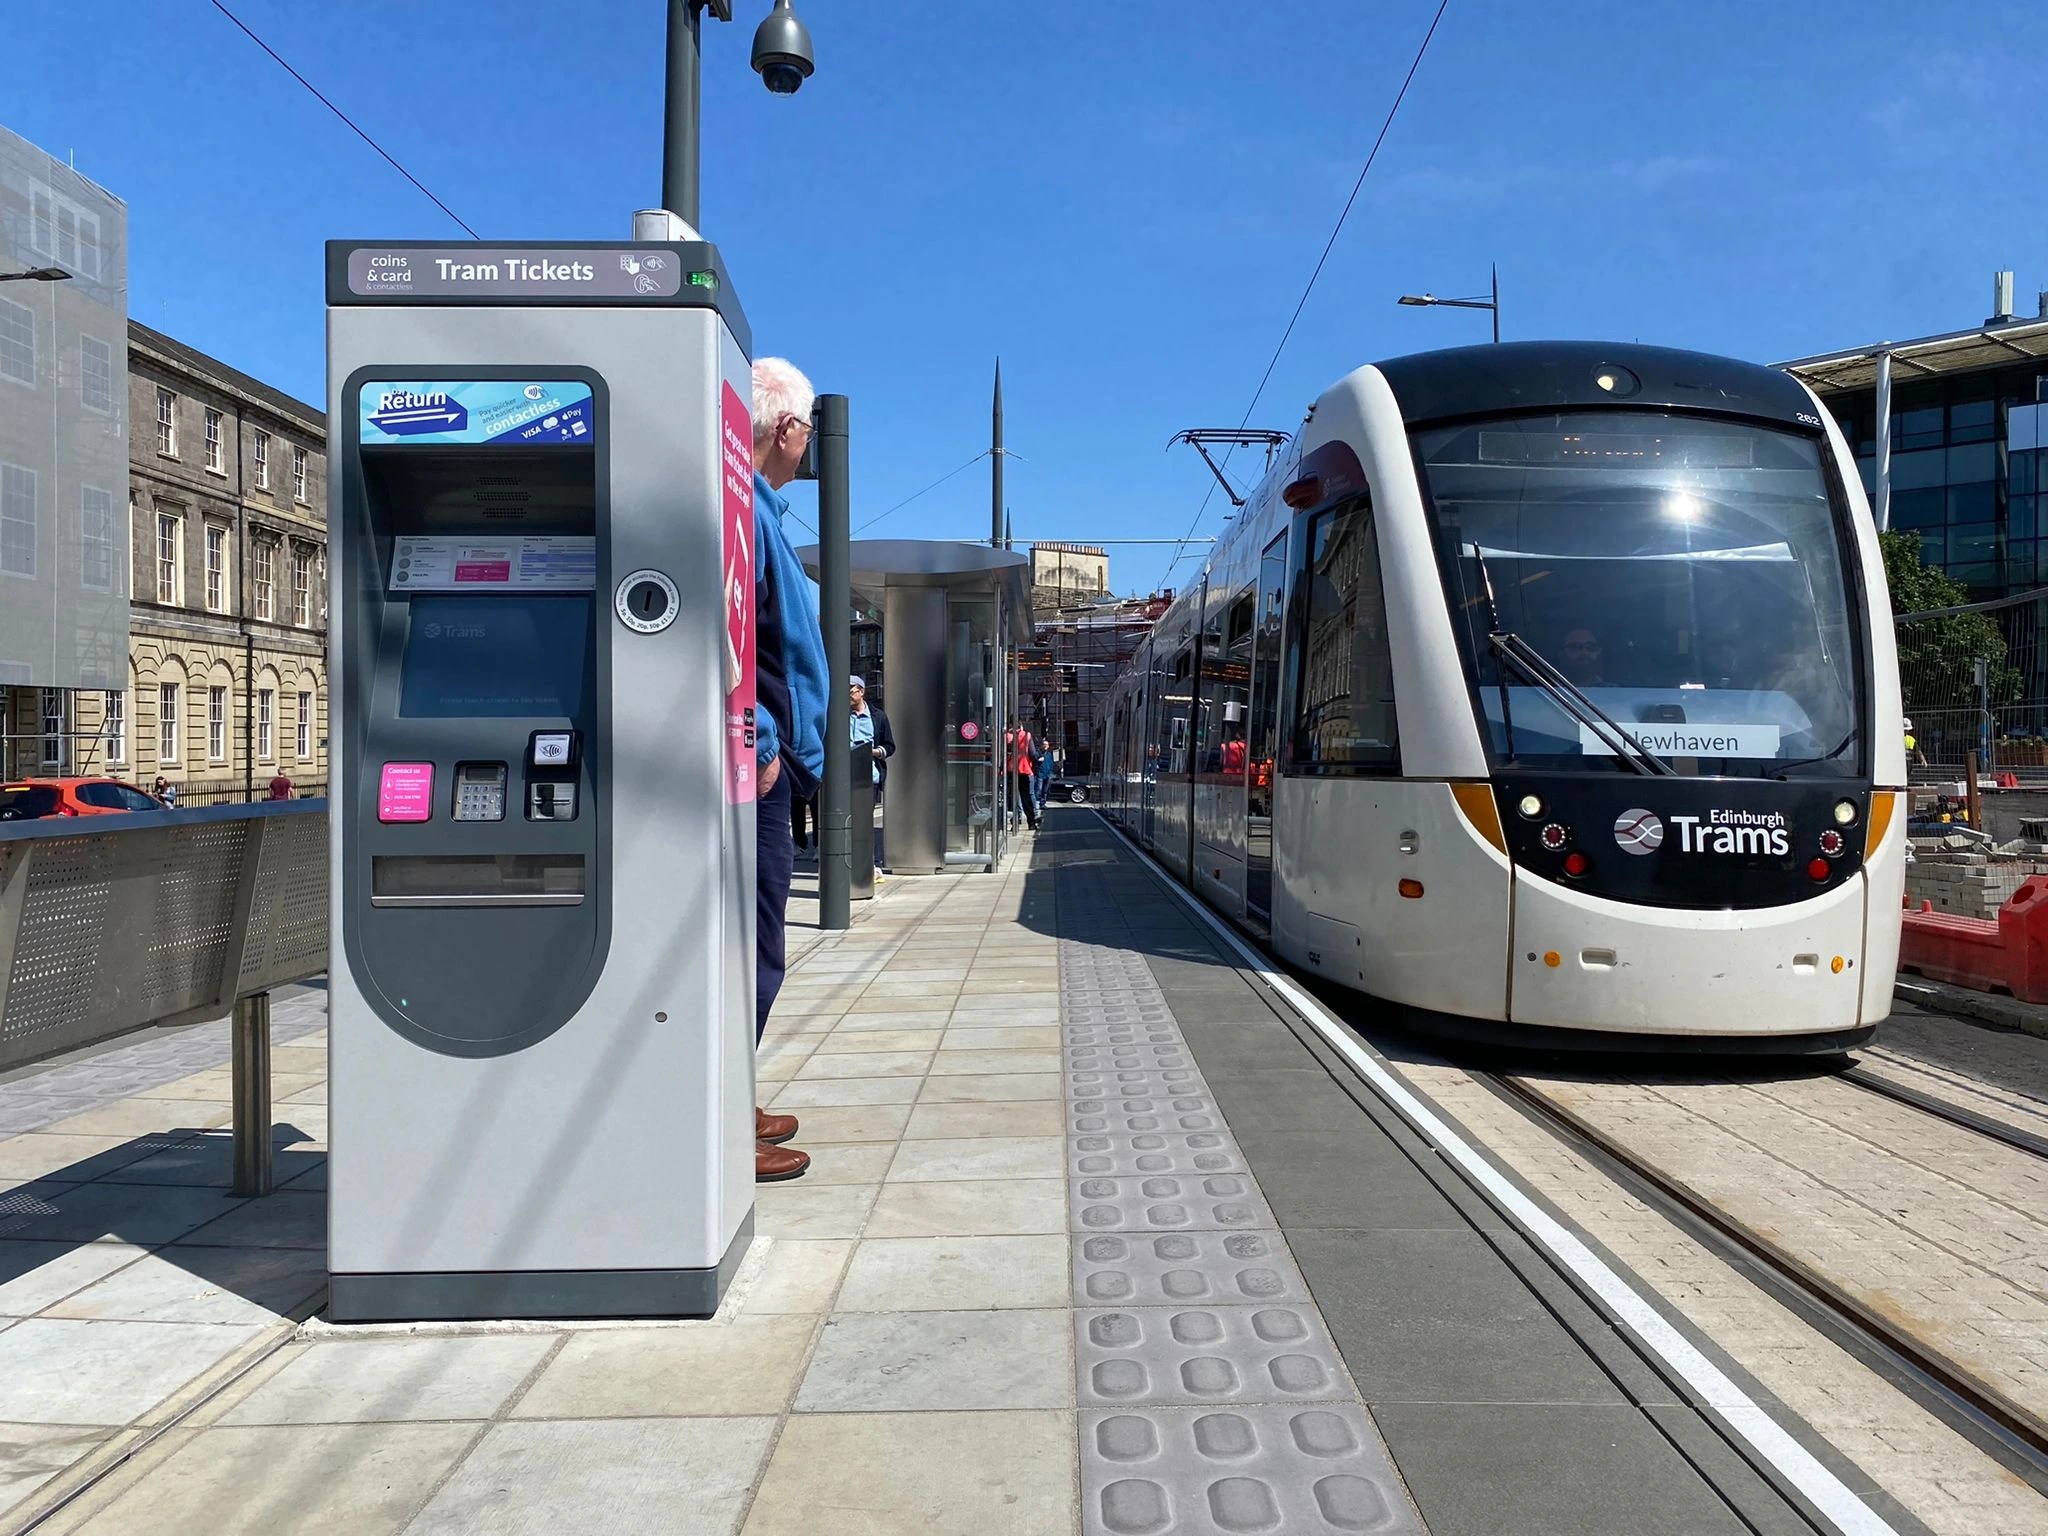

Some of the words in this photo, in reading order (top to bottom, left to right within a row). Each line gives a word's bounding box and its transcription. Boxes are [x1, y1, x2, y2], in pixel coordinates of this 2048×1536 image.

[371, 254, 408, 267] coins
[435, 258, 499, 281] Tram
[504, 257, 595, 281] Tickets
[367, 269, 378, 281] &
[381, 269, 412, 281] card
[379, 391, 447, 411] Return
[478, 408, 491, 417] Pay
[492, 398, 516, 413] quicker
[486, 398, 561, 435] contactless
[567, 408, 582, 419] Pay
[521, 425, 542, 439] VISA
[443, 624, 486, 638] Trams
[1710, 809, 1785, 829] Edinburgh
[1670, 816, 1789, 856] Trams
